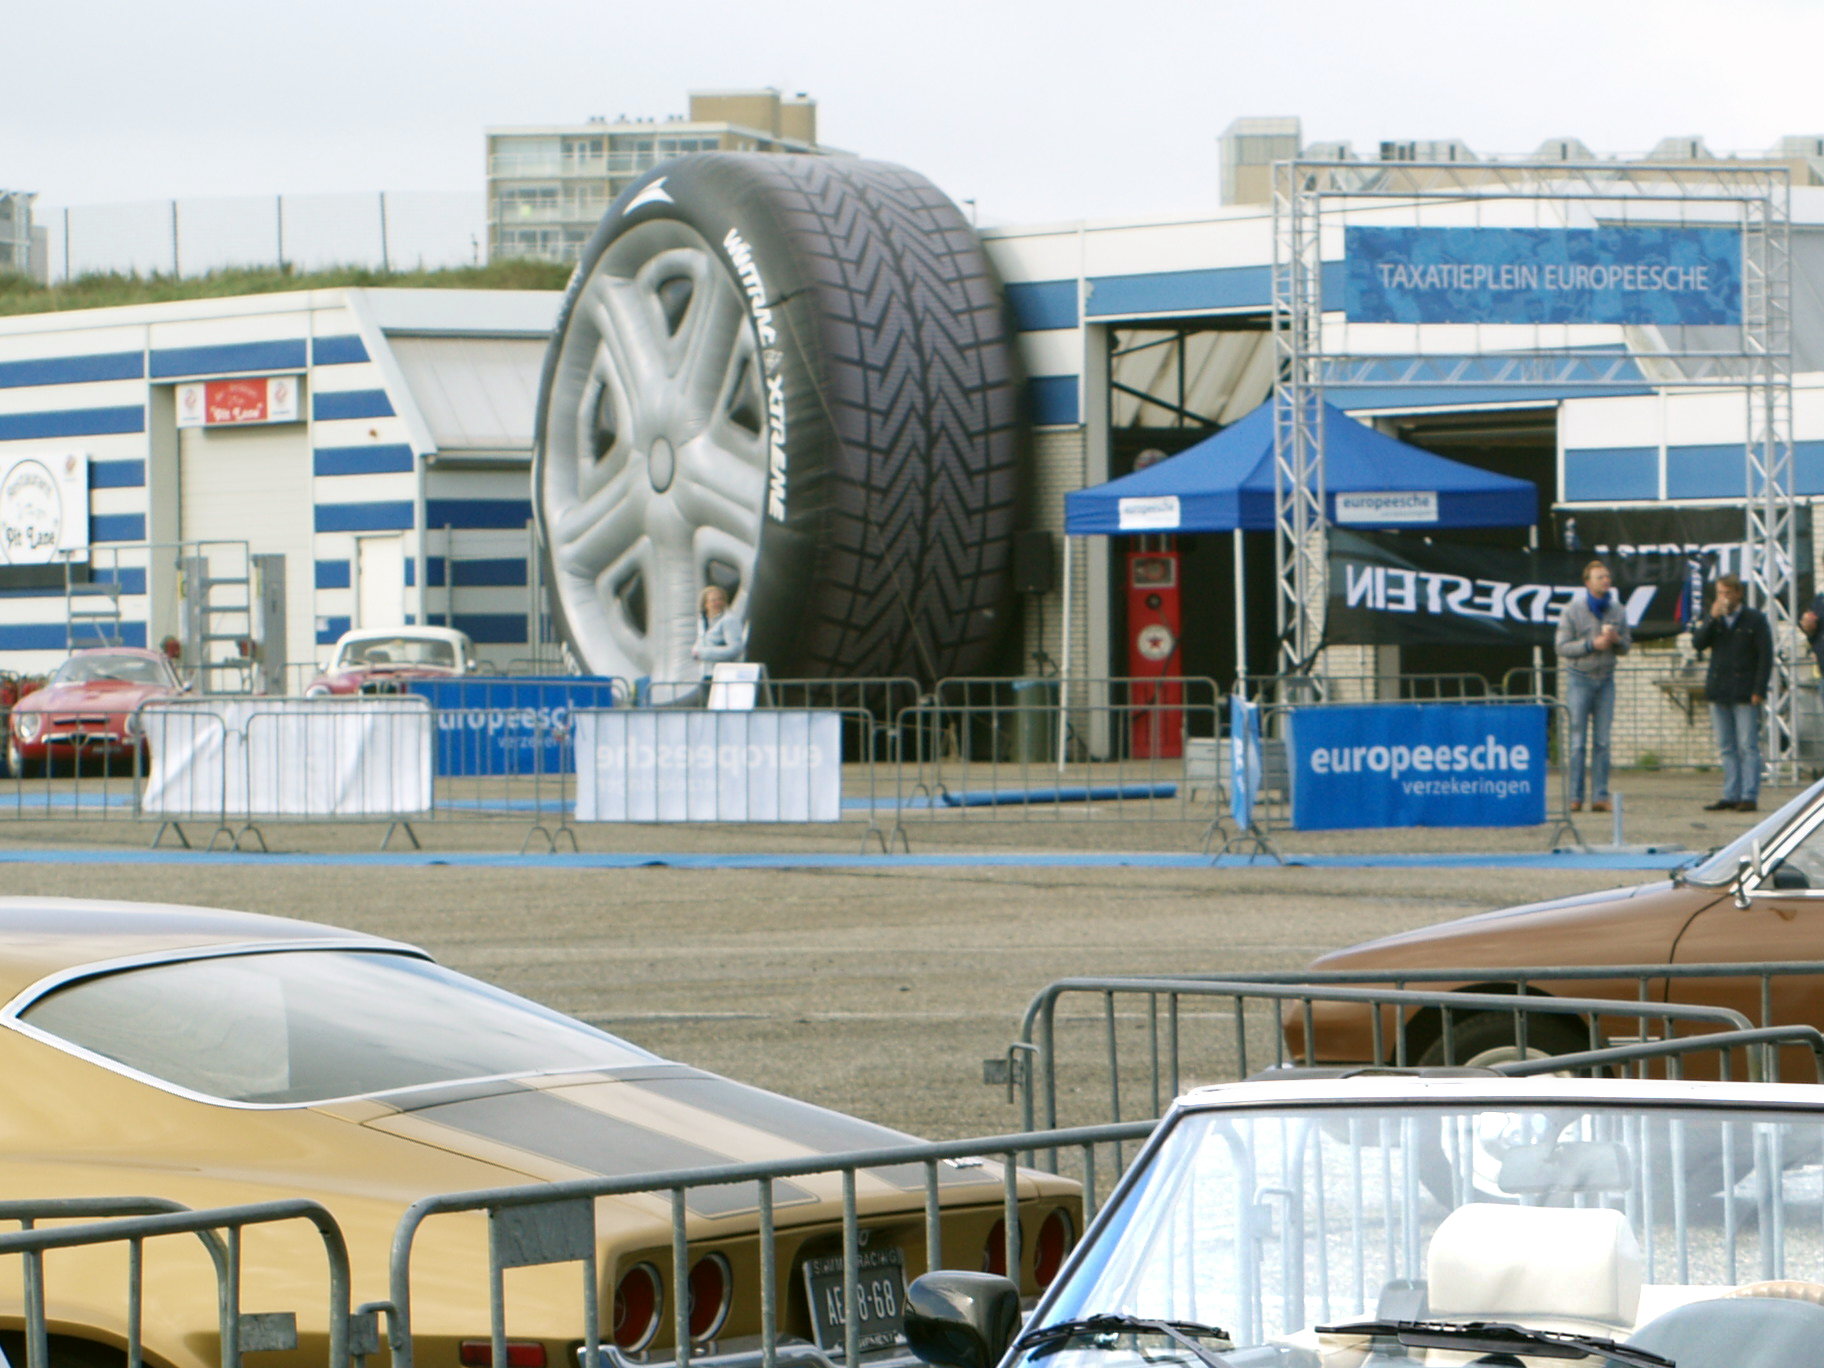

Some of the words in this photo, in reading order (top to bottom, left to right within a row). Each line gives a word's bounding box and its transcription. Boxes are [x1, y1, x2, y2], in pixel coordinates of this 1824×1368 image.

[1378, 264, 1537, 290] TAXATIEPLEIN
[1545, 264, 1709, 291] EUROPEESCHE
[1343, 496, 1430, 510] europeesche
[1311, 735, 1530, 780] europeesche
[1403, 777, 1531, 798] verzekeringen
